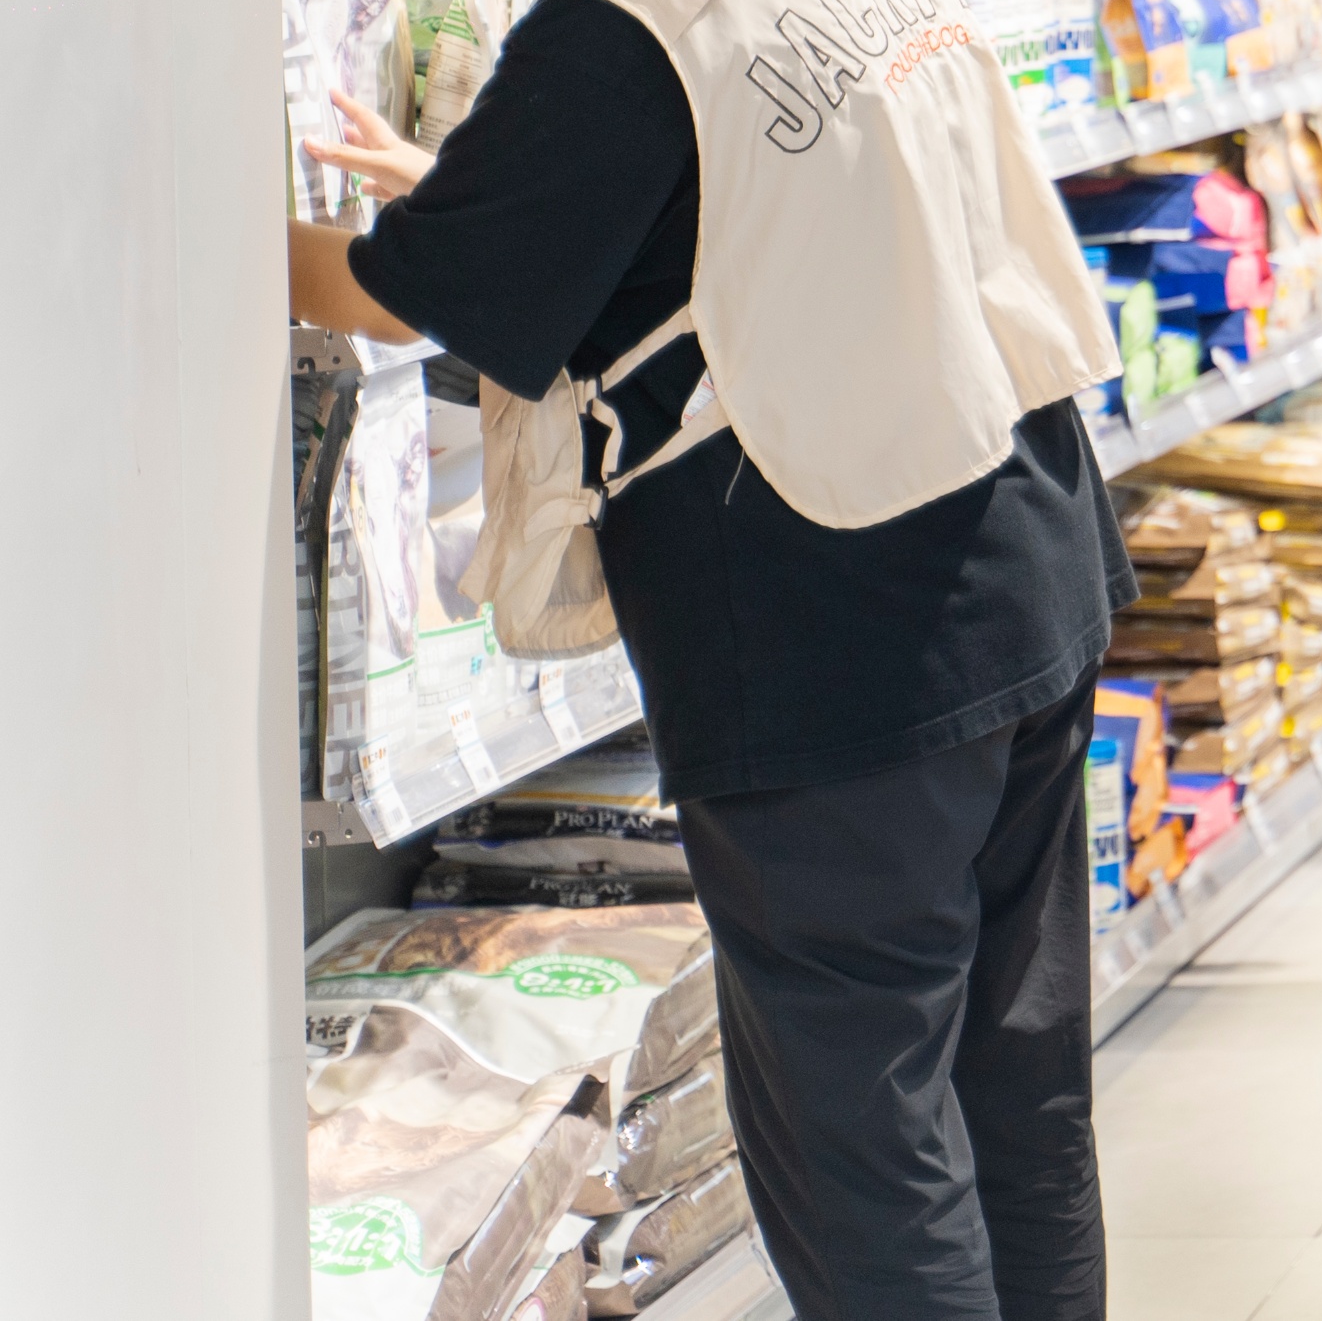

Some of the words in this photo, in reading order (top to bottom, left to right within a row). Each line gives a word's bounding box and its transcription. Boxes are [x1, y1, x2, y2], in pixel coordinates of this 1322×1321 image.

[884, 24, 970, 95] TOUCHDOG
[555, 811, 593, 827] PRO
[598, 811, 655, 828] PLAN
